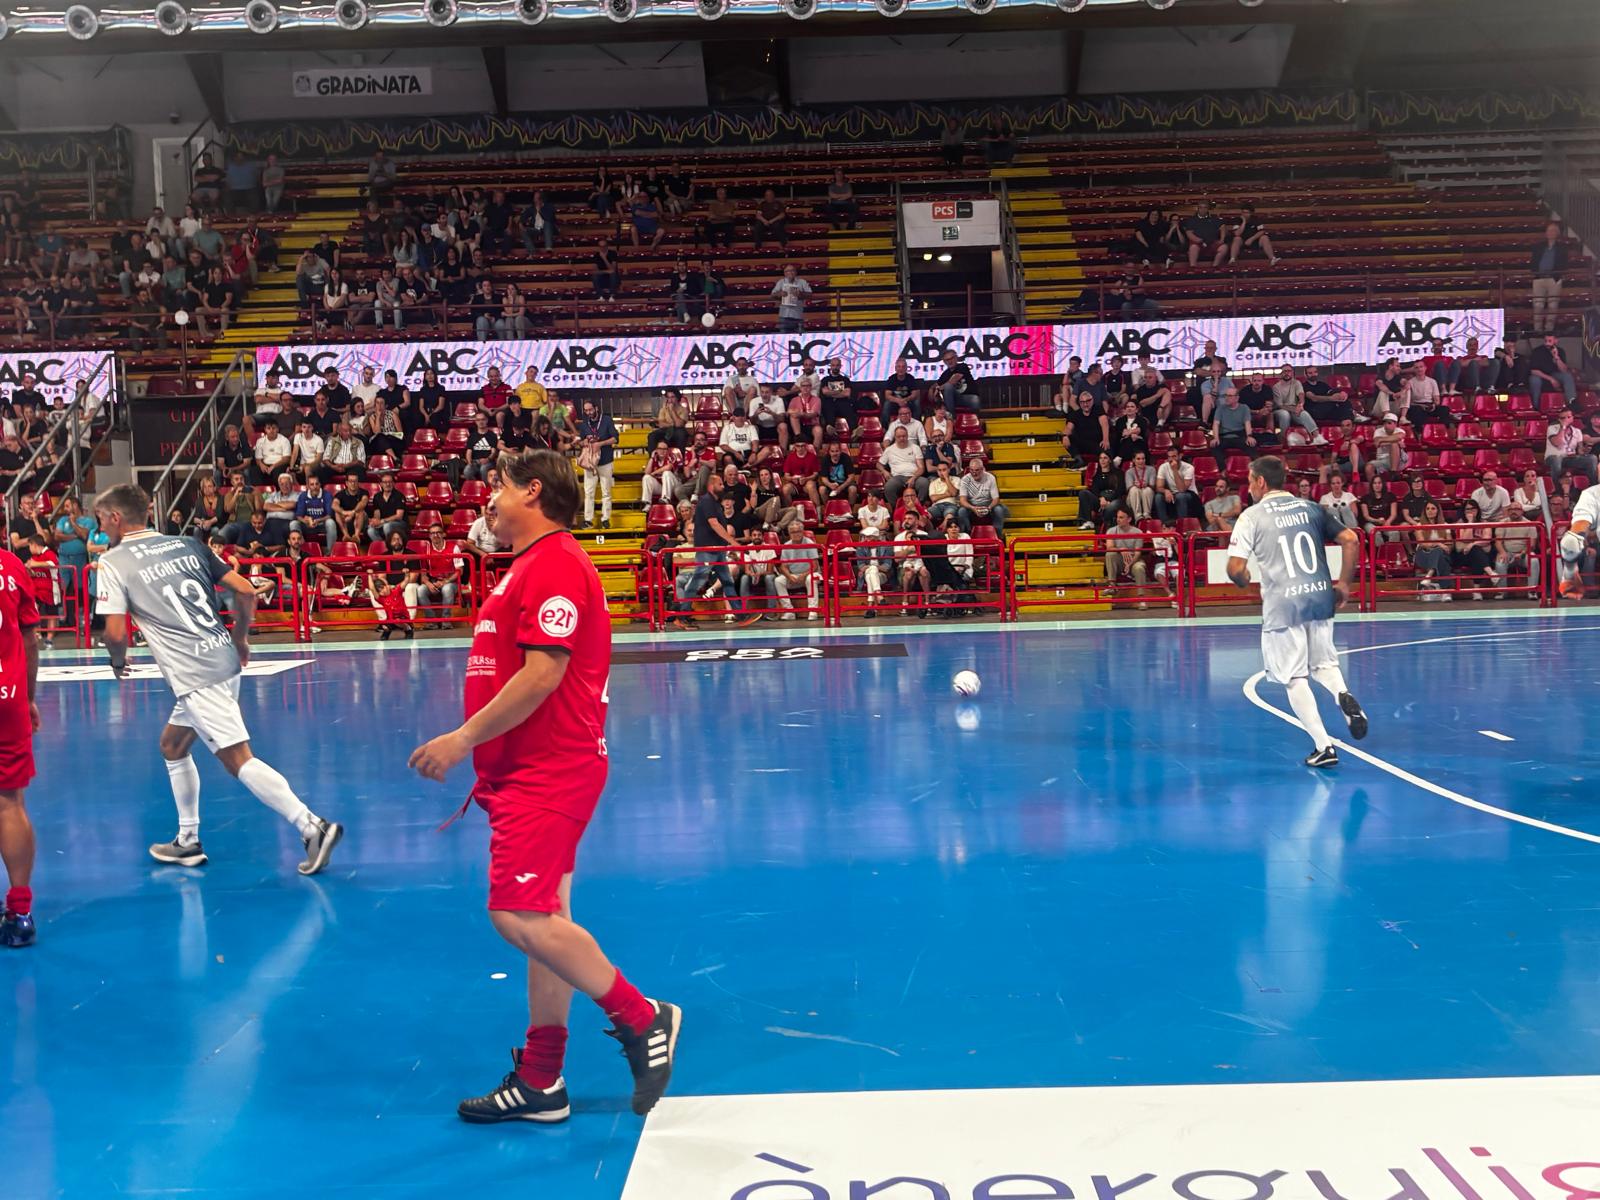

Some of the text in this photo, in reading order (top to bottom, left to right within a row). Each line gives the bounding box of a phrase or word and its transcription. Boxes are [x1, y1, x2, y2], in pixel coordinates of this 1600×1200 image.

[934, 206, 954, 216] PCS
[1096, 328, 1171, 357] ABC
[1237, 323, 1313, 352] ABC
[1378, 316, 1454, 347] ABC
[269, 352, 340, 379] ABC
[405, 348, 480, 376] ABC
[543, 345, 618, 373] ABC
[681, 341, 756, 370] ABC
[1236, 351, 1313, 361] COPERTURE
[0, 359, 66, 386] ABC
[543, 373, 619, 382] COPERTURE
[1275, 511, 1309, 528] GIUNTI
[1278, 531, 1318, 579] 10
[138, 555, 200, 584] BEGHETTO
[163, 579, 218, 634] 13
